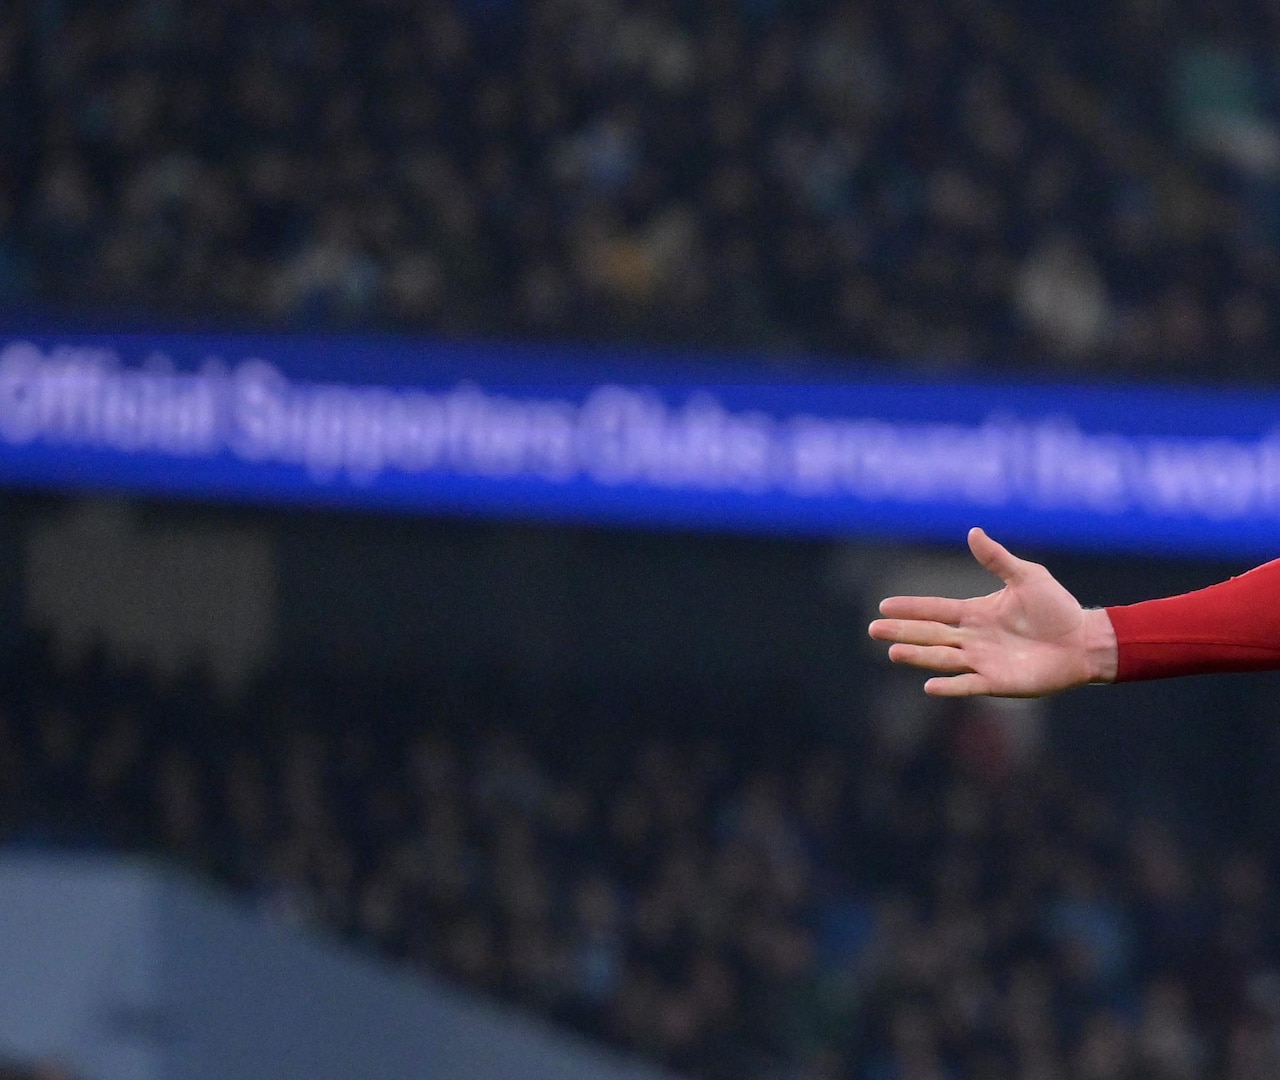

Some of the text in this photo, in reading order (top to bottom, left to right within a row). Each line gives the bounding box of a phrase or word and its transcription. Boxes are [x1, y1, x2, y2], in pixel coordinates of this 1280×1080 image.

[232, 358, 577, 485] Supporters
[580, 385, 771, 493] Clubs
[789, 410, 1006, 506] around
[1009, 412, 1131, 513] the
